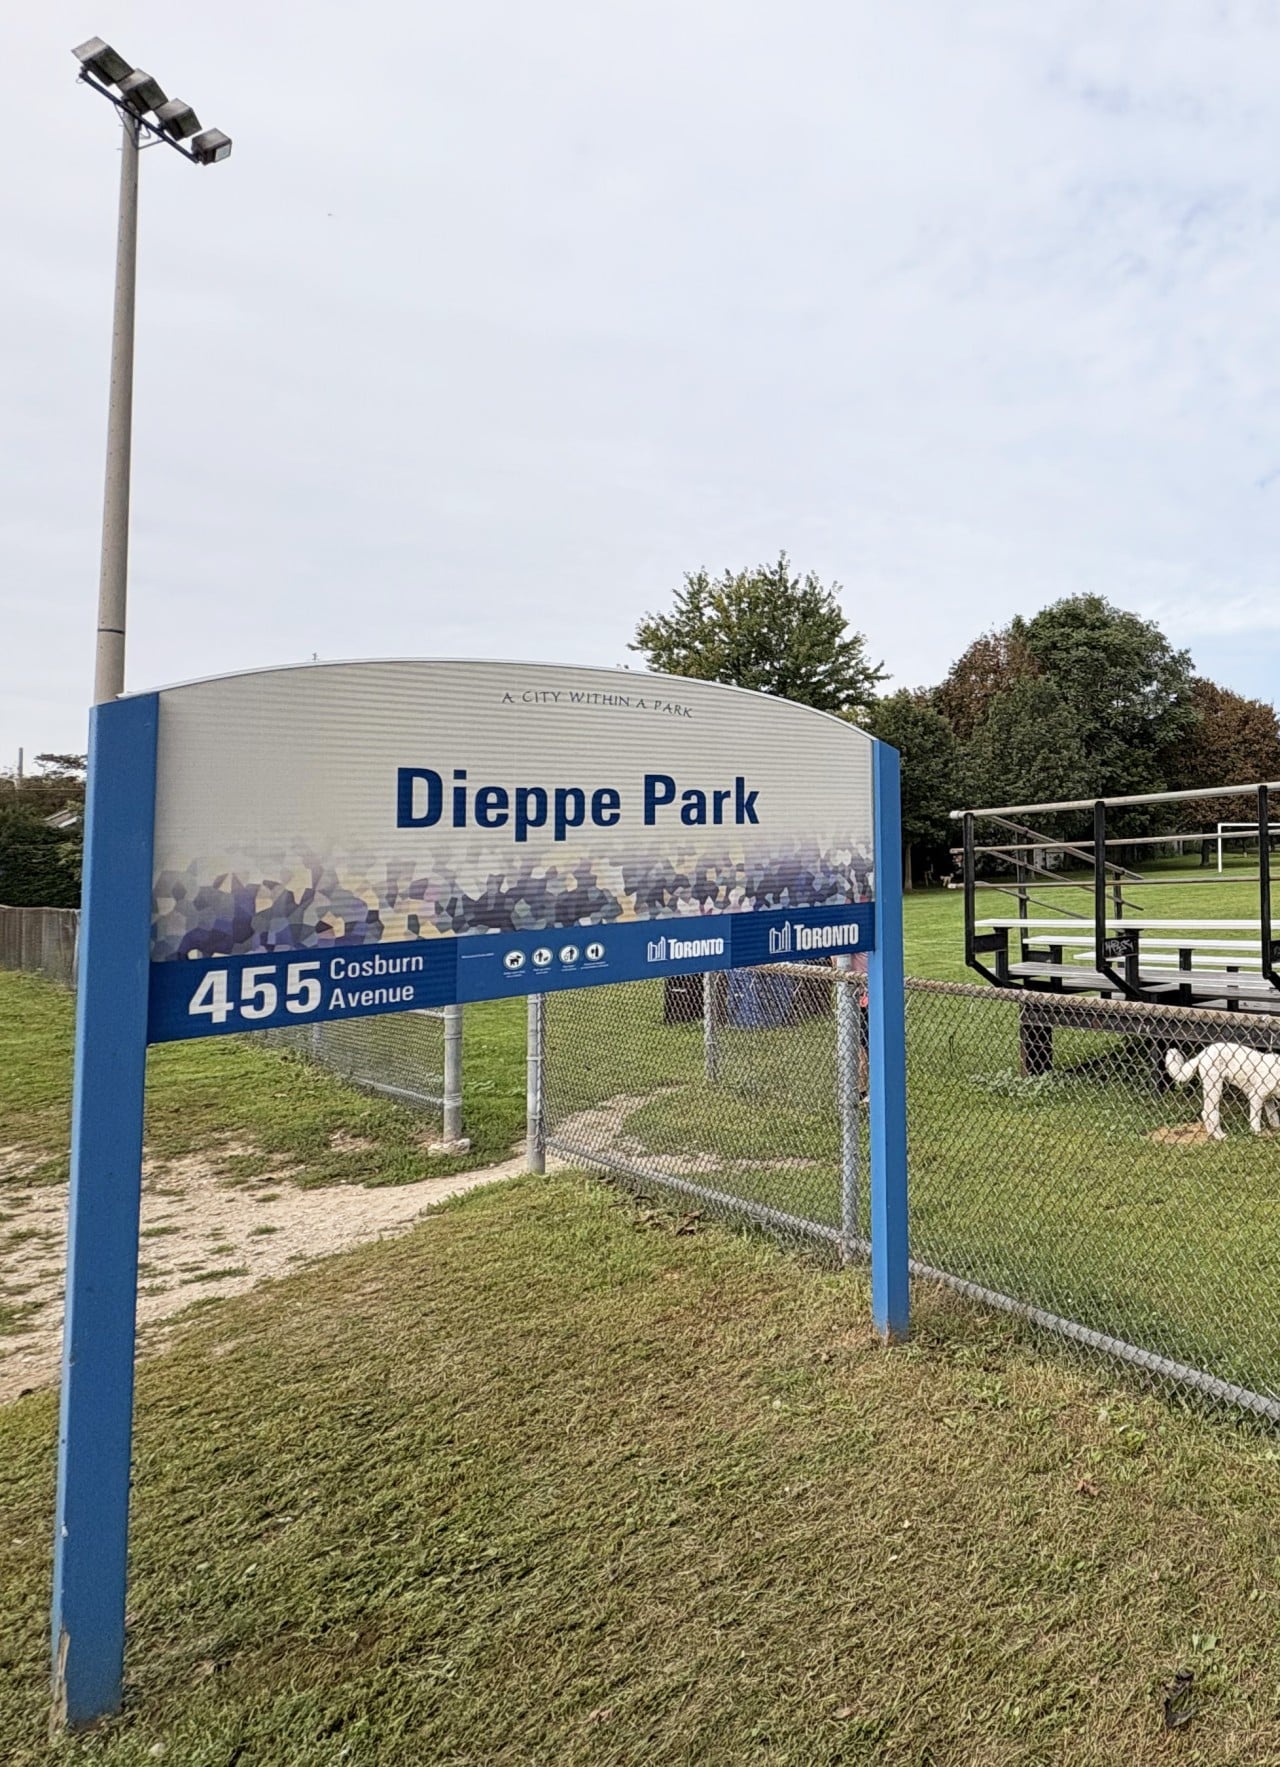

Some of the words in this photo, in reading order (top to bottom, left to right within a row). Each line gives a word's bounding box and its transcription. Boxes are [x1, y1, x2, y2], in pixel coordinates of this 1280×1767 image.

[501, 692, 515, 704] A
[522, 691, 561, 704] CITY
[569, 691, 630, 707] WITHIN
[636, 698, 648, 709] A
[653, 700, 693, 718] PARK
[396, 767, 621, 843] Dieppe
[644, 774, 760, 826] Park
[668, 937, 724, 960] TORONTO
[793, 923, 859, 951] TORONTO
[329, 954, 424, 980] Cosburn
[188, 961, 322, 1024] 455
[328, 985, 415, 1011] Avenue
